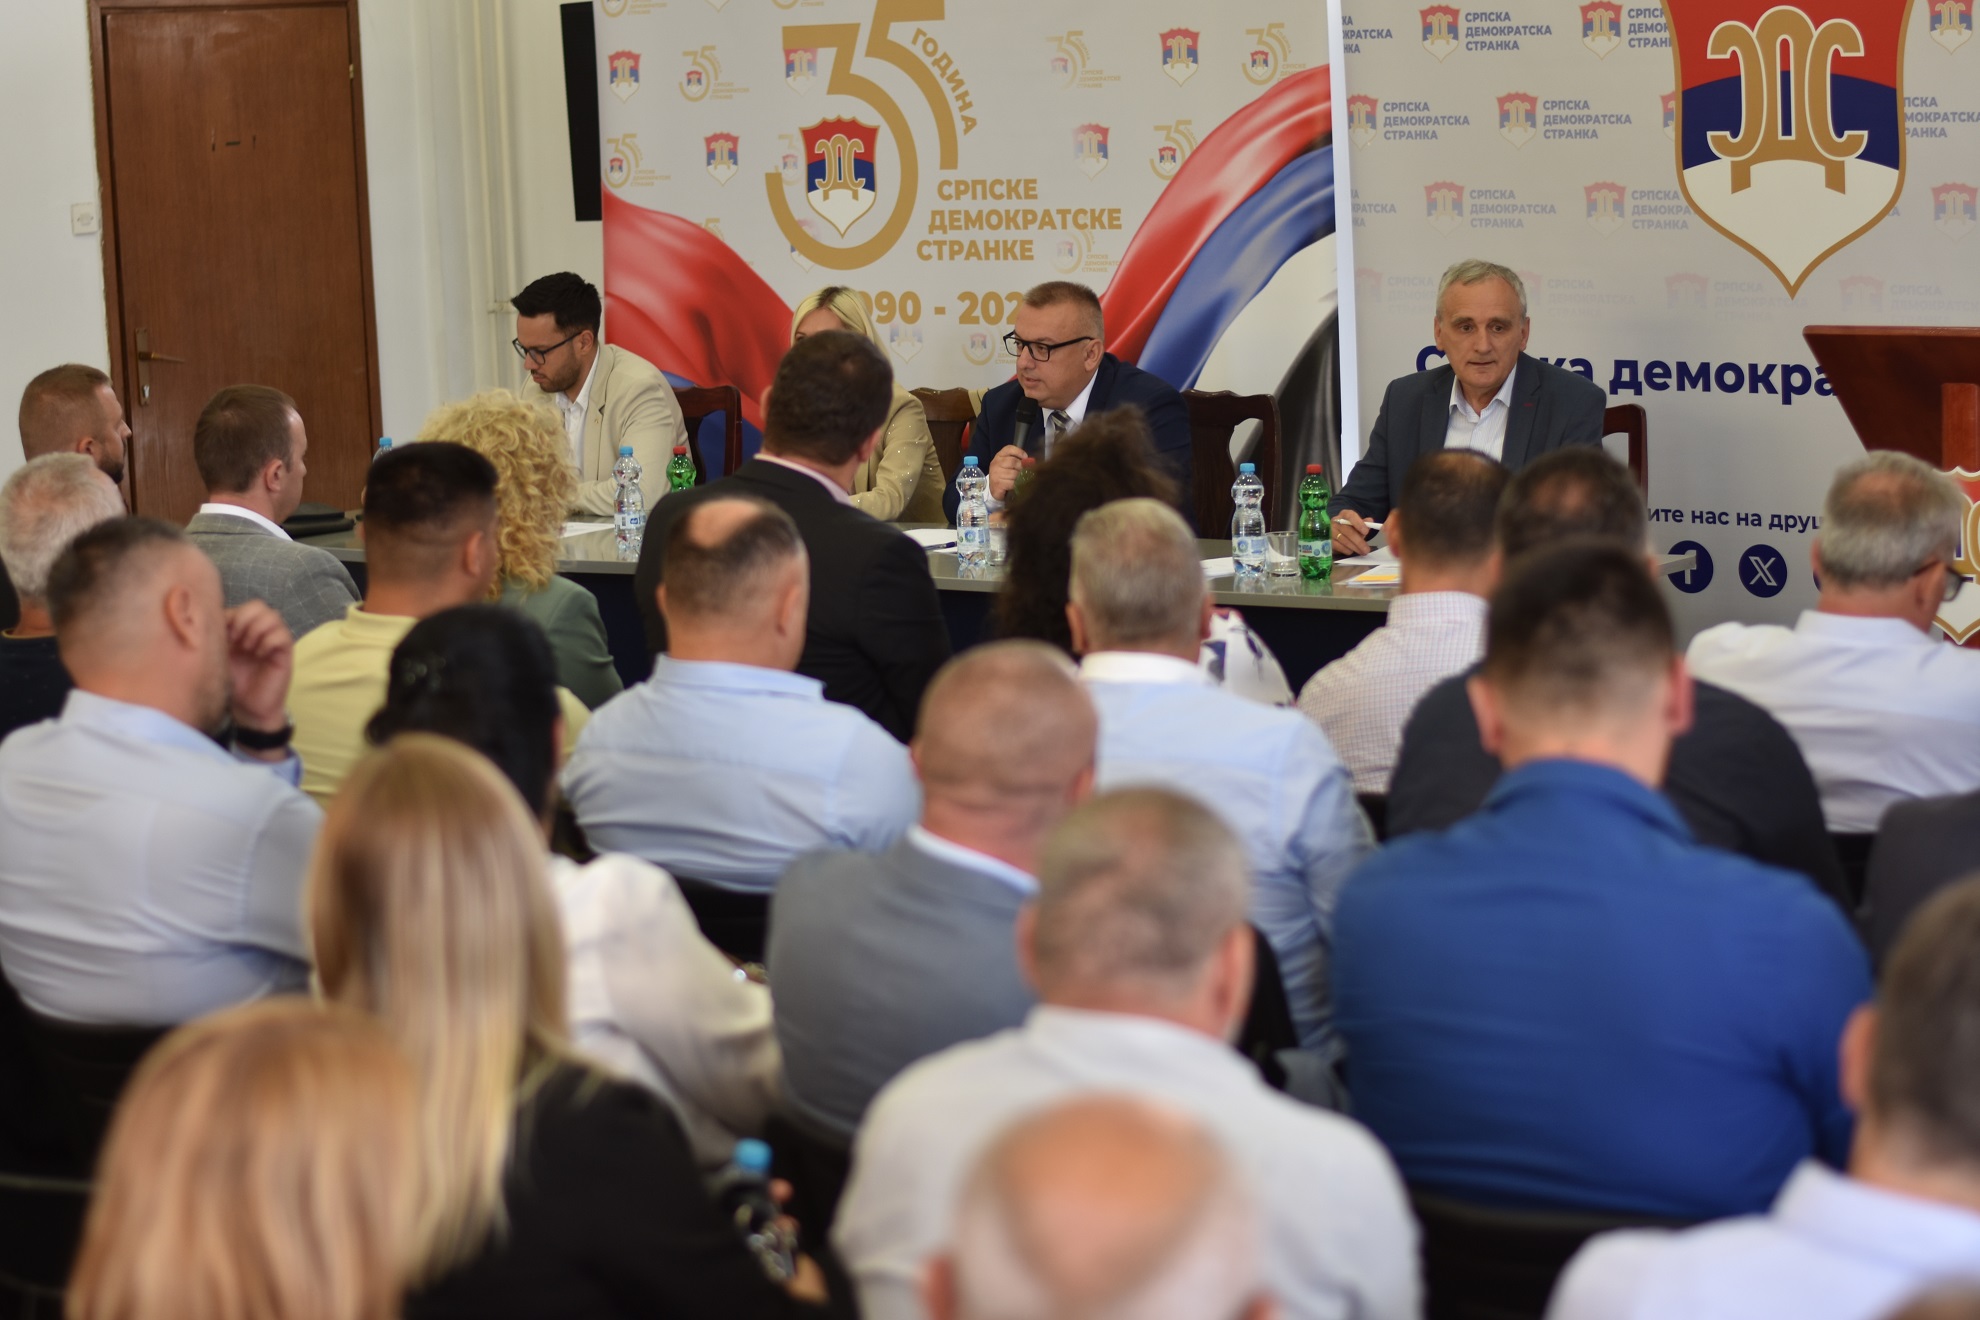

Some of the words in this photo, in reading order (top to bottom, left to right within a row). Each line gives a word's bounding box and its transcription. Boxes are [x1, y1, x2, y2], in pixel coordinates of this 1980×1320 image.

[1464, 11, 1511, 23] СРПСКА
[1465, 25, 1552, 38] ДЕМОКРАТСКА
[1465, 40, 1520, 51] СТРАНКА
[911, 27, 978, 136] ГОДИНА
[1383, 102, 1430, 113] СРПСКА
[1543, 100, 1590, 111] СРПСКА
[1383, 115, 1470, 128] ДЕМОКРАТСКА
[1543, 114, 1632, 127] ДЕМОКРАТСКА
[1383, 130, 1438, 141] СТРАНКА
[1543, 129, 1599, 140] СТРАНКА
[937, 178, 1038, 201] СРПСКЕ
[1469, 189, 1516, 200] СРПСКА
[1631, 190, 1680, 201] СРПСКА
[1469, 203, 1557, 216] ДЕМОКРАТСКА
[1631, 204, 1692, 217] ДЕМОКРА
[928, 207, 1122, 235] ДЕМОКРАТСКЕ
[1470, 218, 1524, 229] СТРАНКА
[1631, 219, 1689, 230] СТРАНКА
[916, 239, 1035, 262] СТРАНКЕ
[957, 290, 1024, 326] 202
[1609, 359, 1839, 406] демокра
[1691, 509, 1730, 525] нас
[1736, 512, 1762, 527] на
